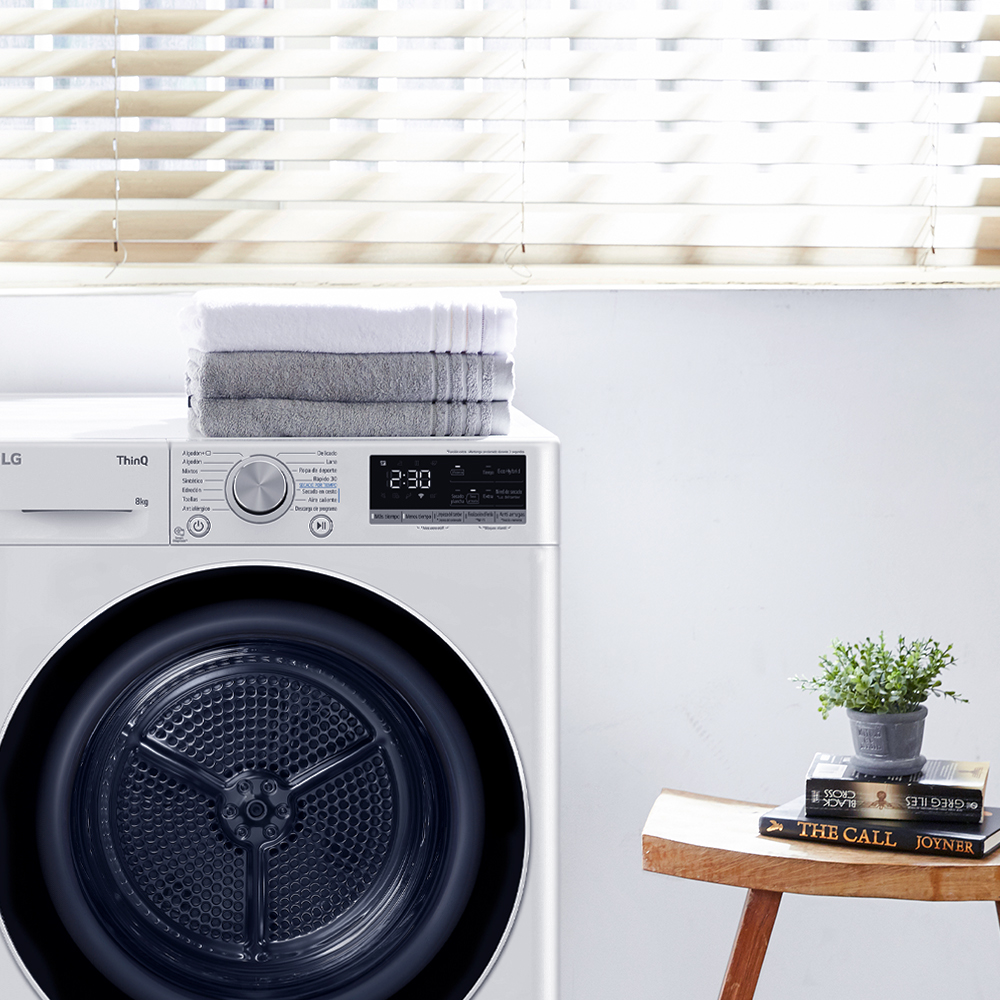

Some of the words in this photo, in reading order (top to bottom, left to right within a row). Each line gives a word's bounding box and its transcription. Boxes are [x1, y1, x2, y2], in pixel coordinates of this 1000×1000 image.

[1, 452, 22, 466] LG
[116, 455, 149, 466] ThinQ
[389, 469, 431, 489] 2:30
[134, 497, 149, 507] 8kg
[824, 788, 856, 799] CROSS
[823, 797, 857, 809] BLACK
[905, 796, 928, 807] ILES
[930, 797, 965, 809] GREG
[797, 821, 839, 841] THE
[842, 826, 898, 848] CALL
[915, 835, 975, 855] JOYNER
